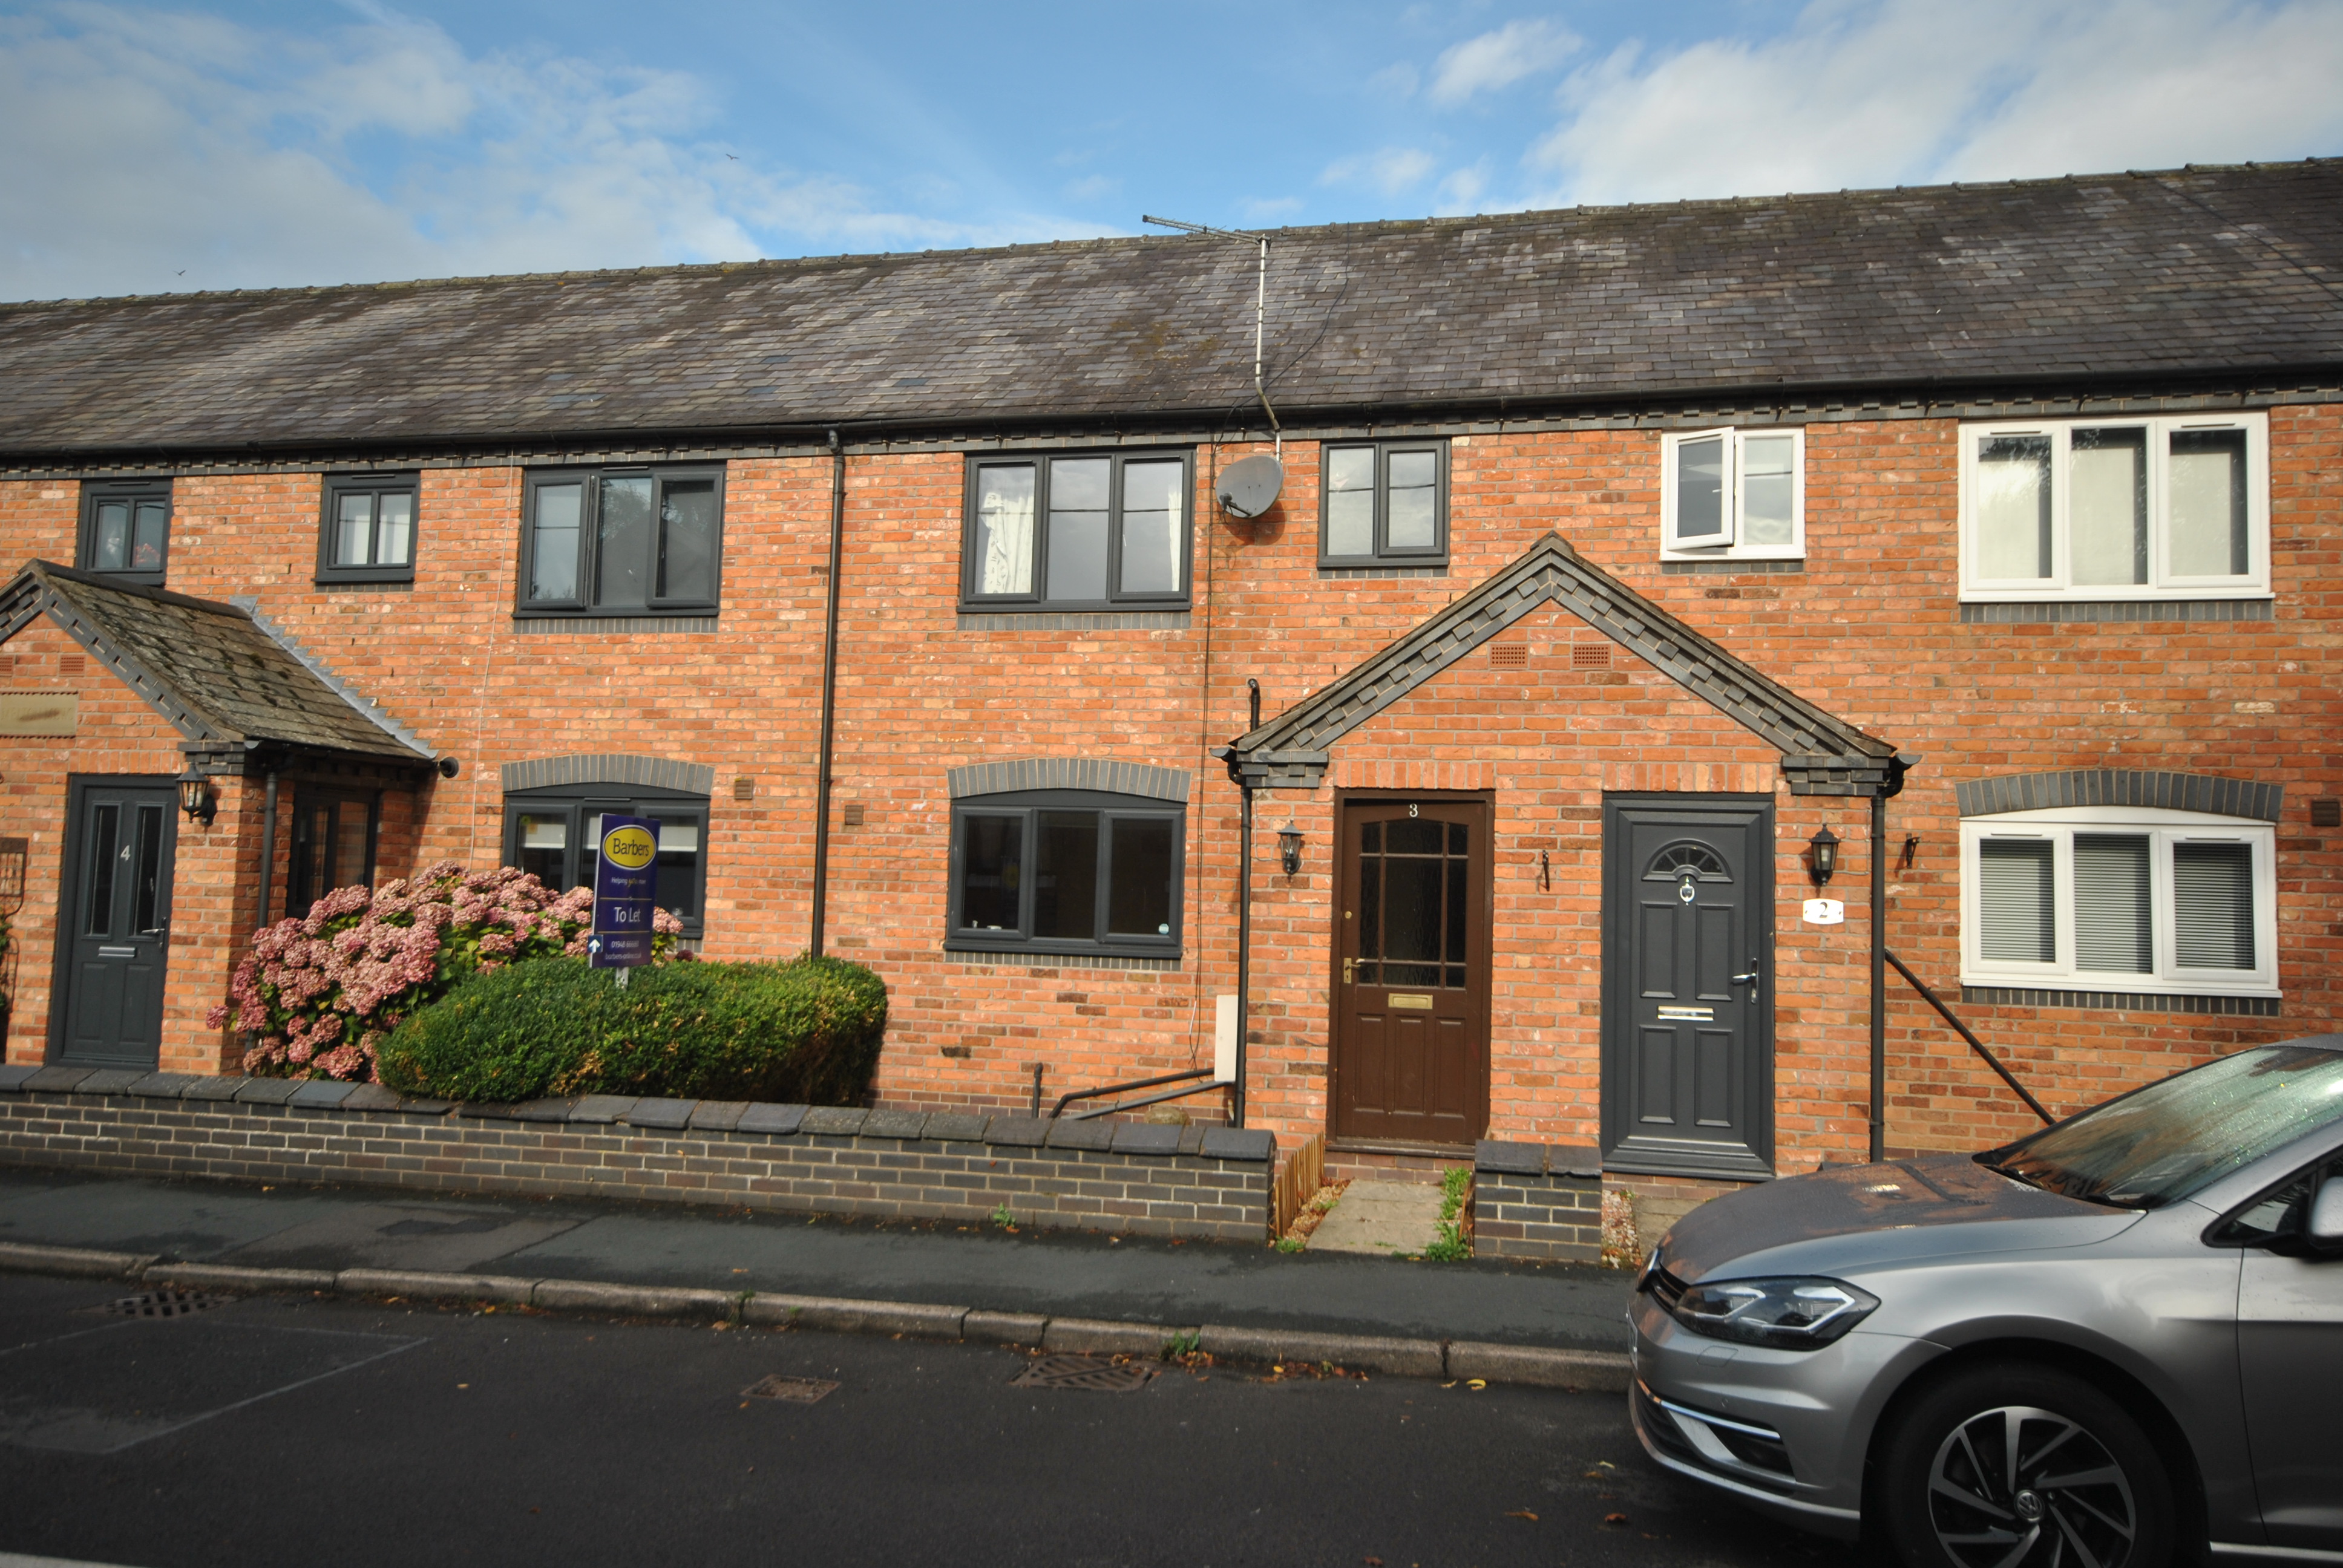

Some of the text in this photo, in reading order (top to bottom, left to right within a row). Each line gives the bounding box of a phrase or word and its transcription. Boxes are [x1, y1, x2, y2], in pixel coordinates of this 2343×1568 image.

[1409, 803, 1418, 817] 3
[120, 844, 131, 861] 4
[613, 837, 649, 857] Barbers
[614, 907, 641, 923] To Let
[1819, 901, 1828, 918] 2
